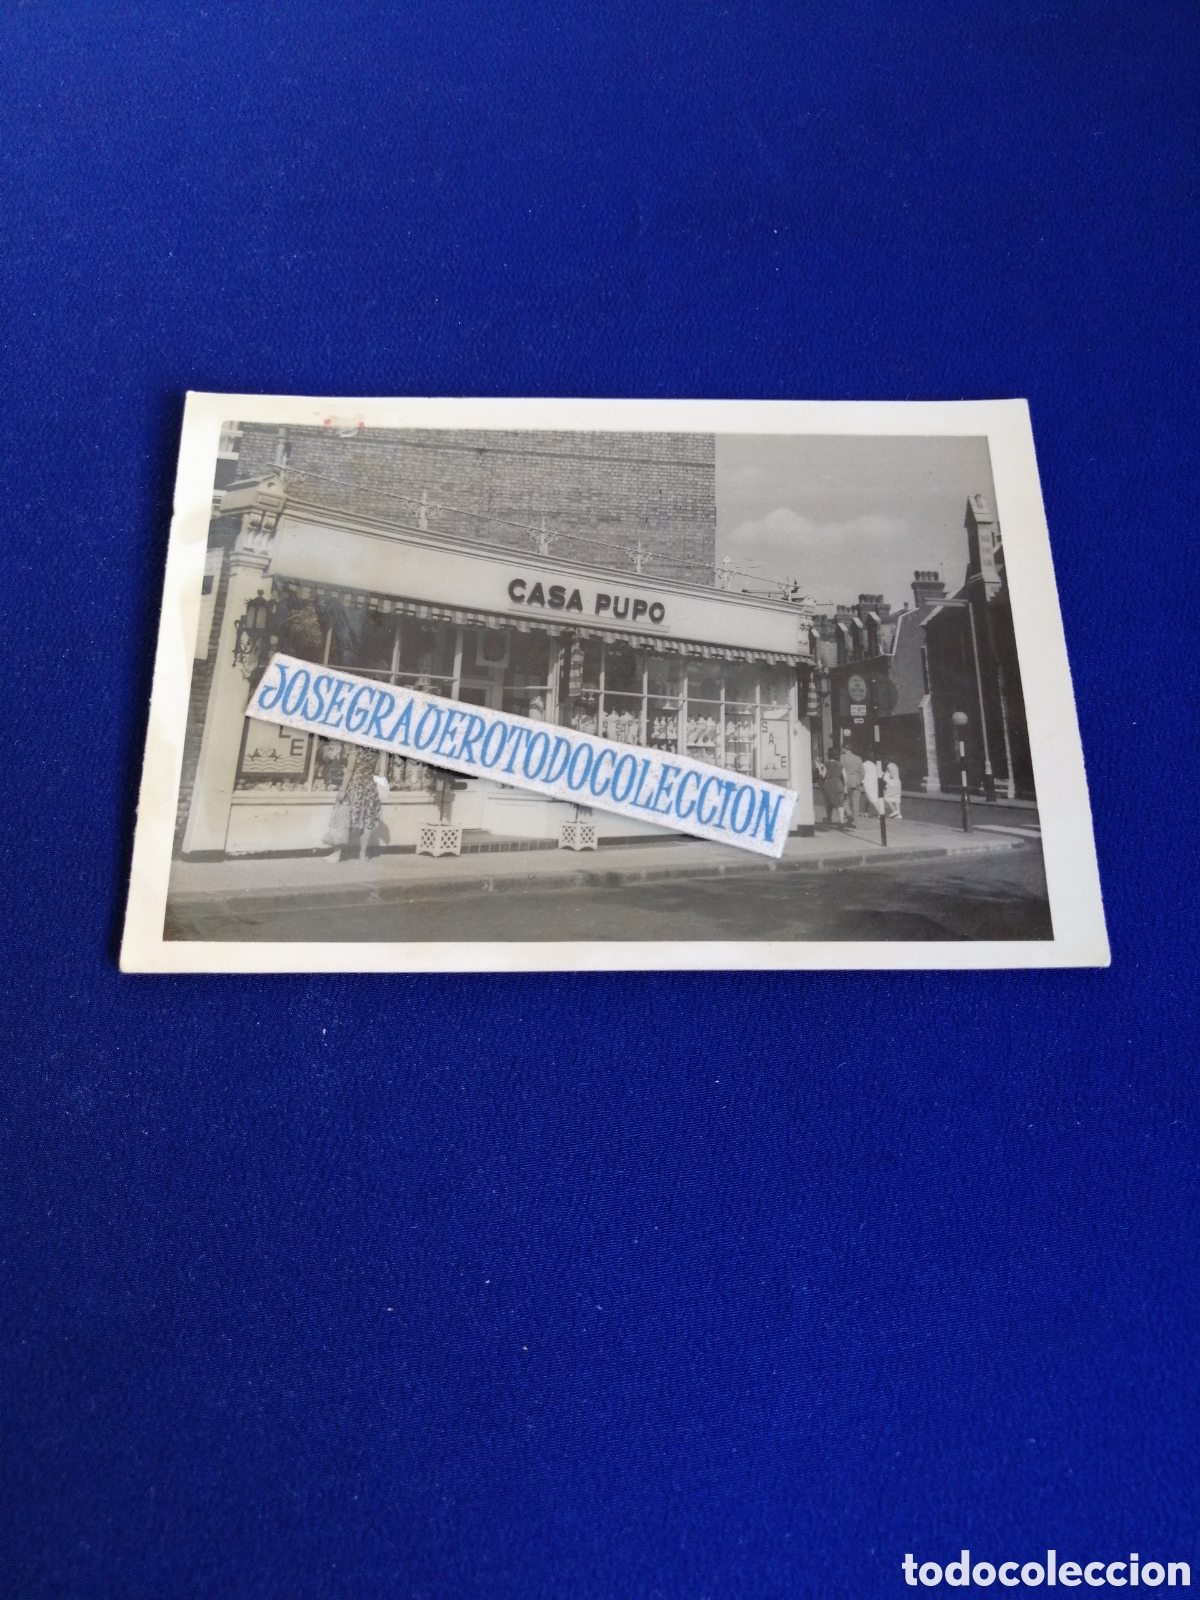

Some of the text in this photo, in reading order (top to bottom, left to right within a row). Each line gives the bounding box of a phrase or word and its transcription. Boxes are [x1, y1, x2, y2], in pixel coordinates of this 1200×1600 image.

[507, 578, 666, 625] CASA PUPO
[615, 722, 633, 734] SAT
[761, 721, 787, 768] SALE
